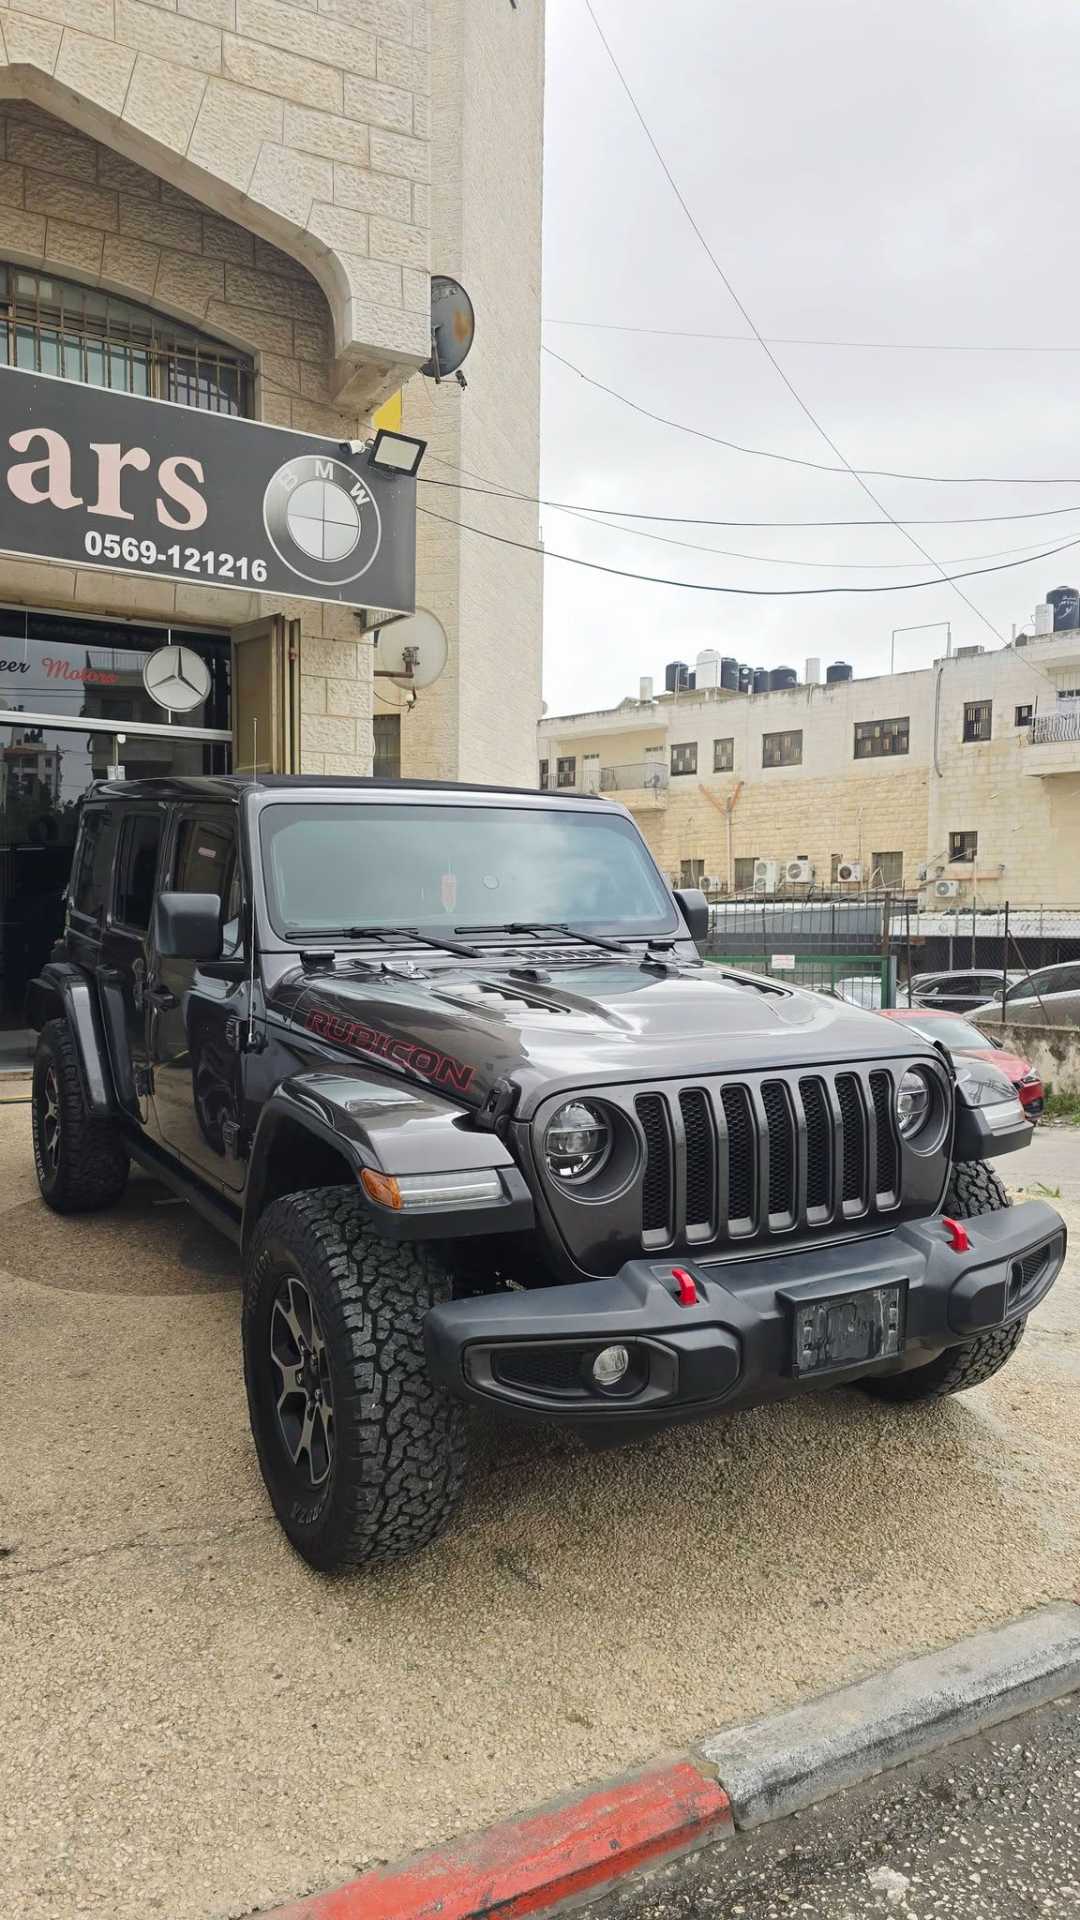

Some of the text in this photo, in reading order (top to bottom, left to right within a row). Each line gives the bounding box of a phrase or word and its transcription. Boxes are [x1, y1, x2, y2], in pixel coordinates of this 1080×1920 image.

[7, 427, 208, 531] ars
[280, 459, 371, 506] BMW
[84, 530, 268, 583] 0569-121216
[41, 657, 119, 684] Motors
[303, 1008, 477, 1092] RUBICON
